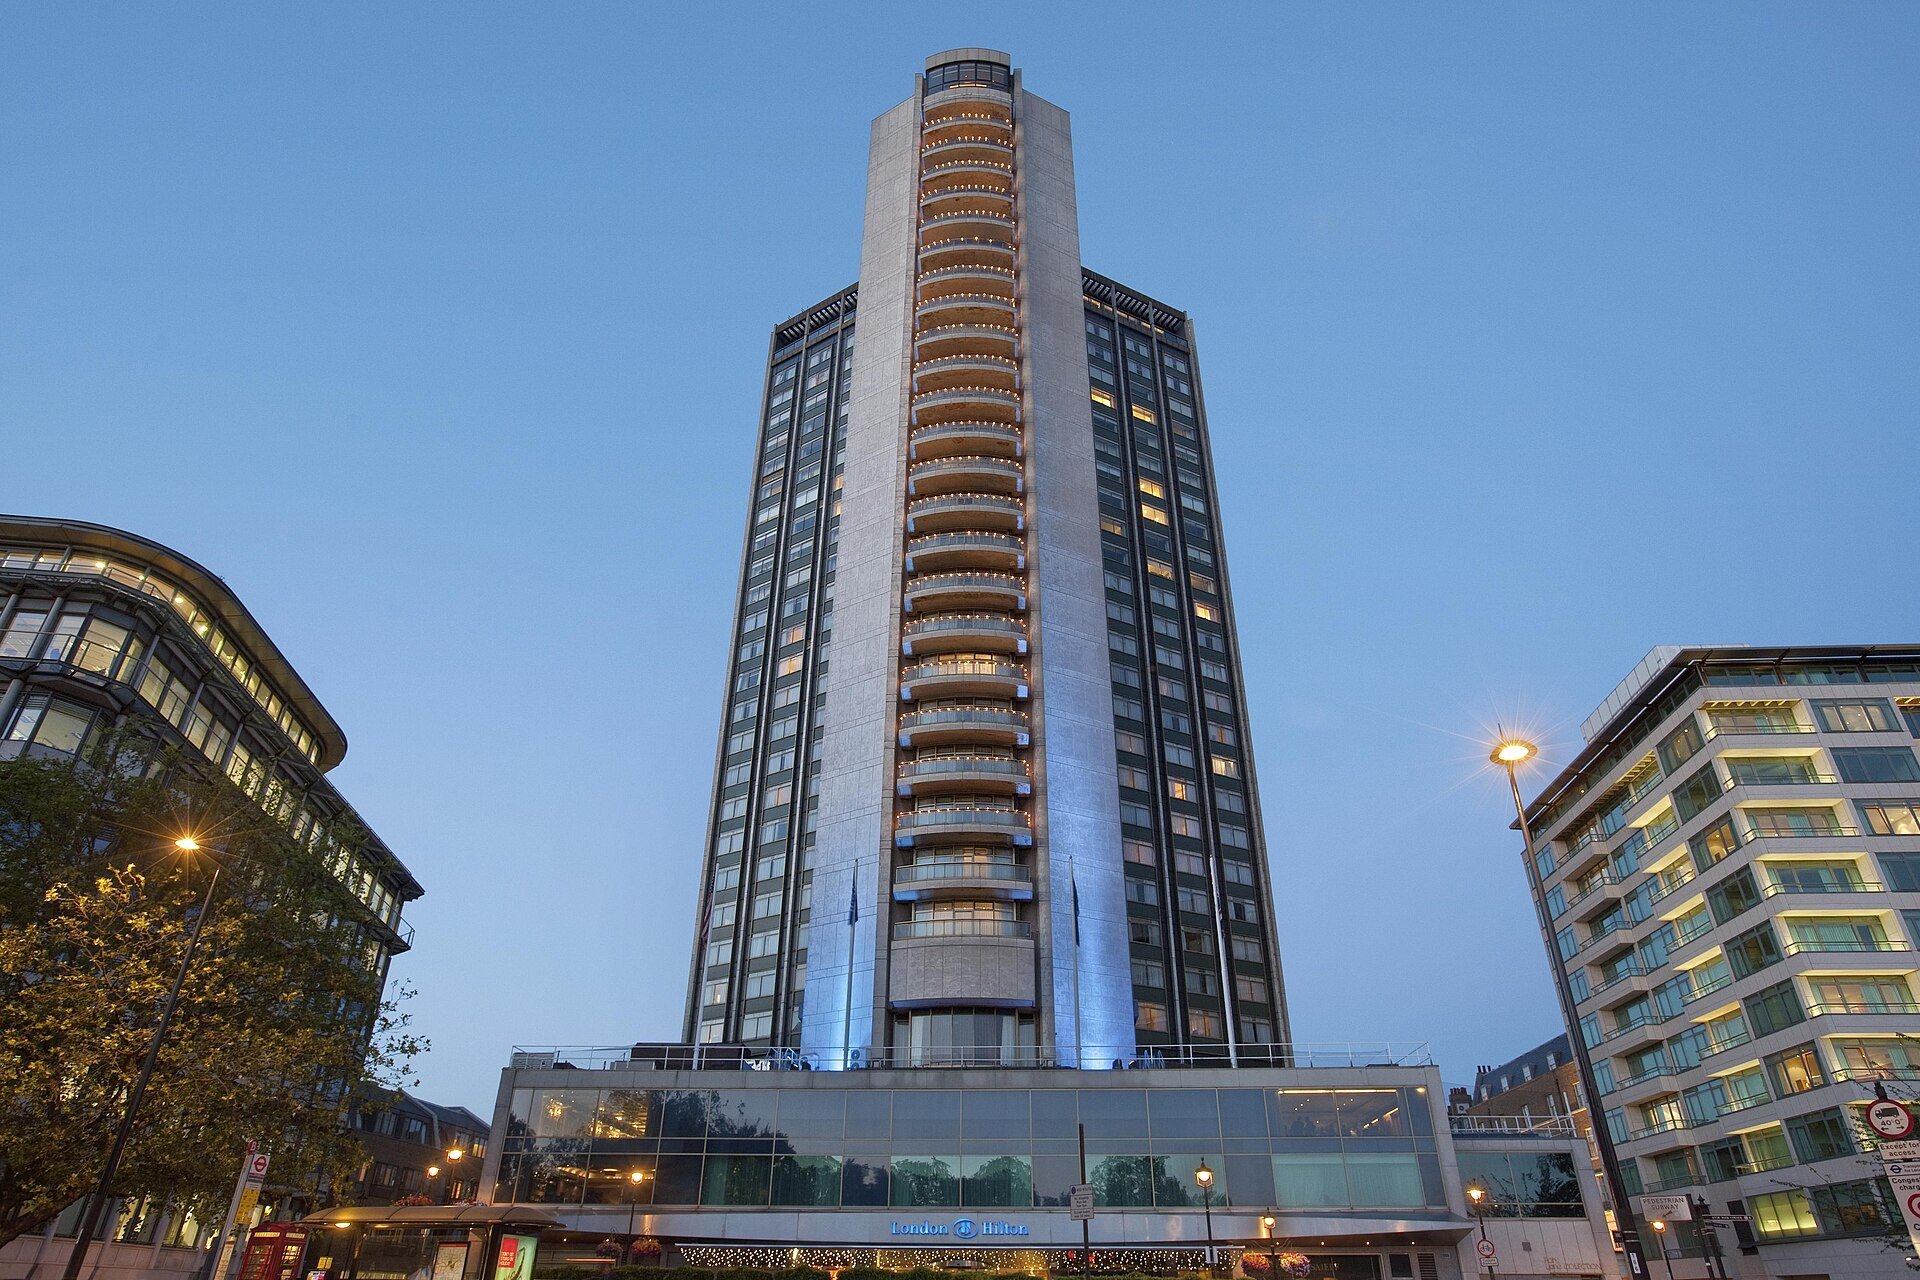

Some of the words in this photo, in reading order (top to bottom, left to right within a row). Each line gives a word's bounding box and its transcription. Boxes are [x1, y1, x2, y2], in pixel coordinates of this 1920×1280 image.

[1880, 1142, 1907, 1150] Except
[891, 1220, 949, 1235] London
[982, 1220, 1029, 1235] Hilton
